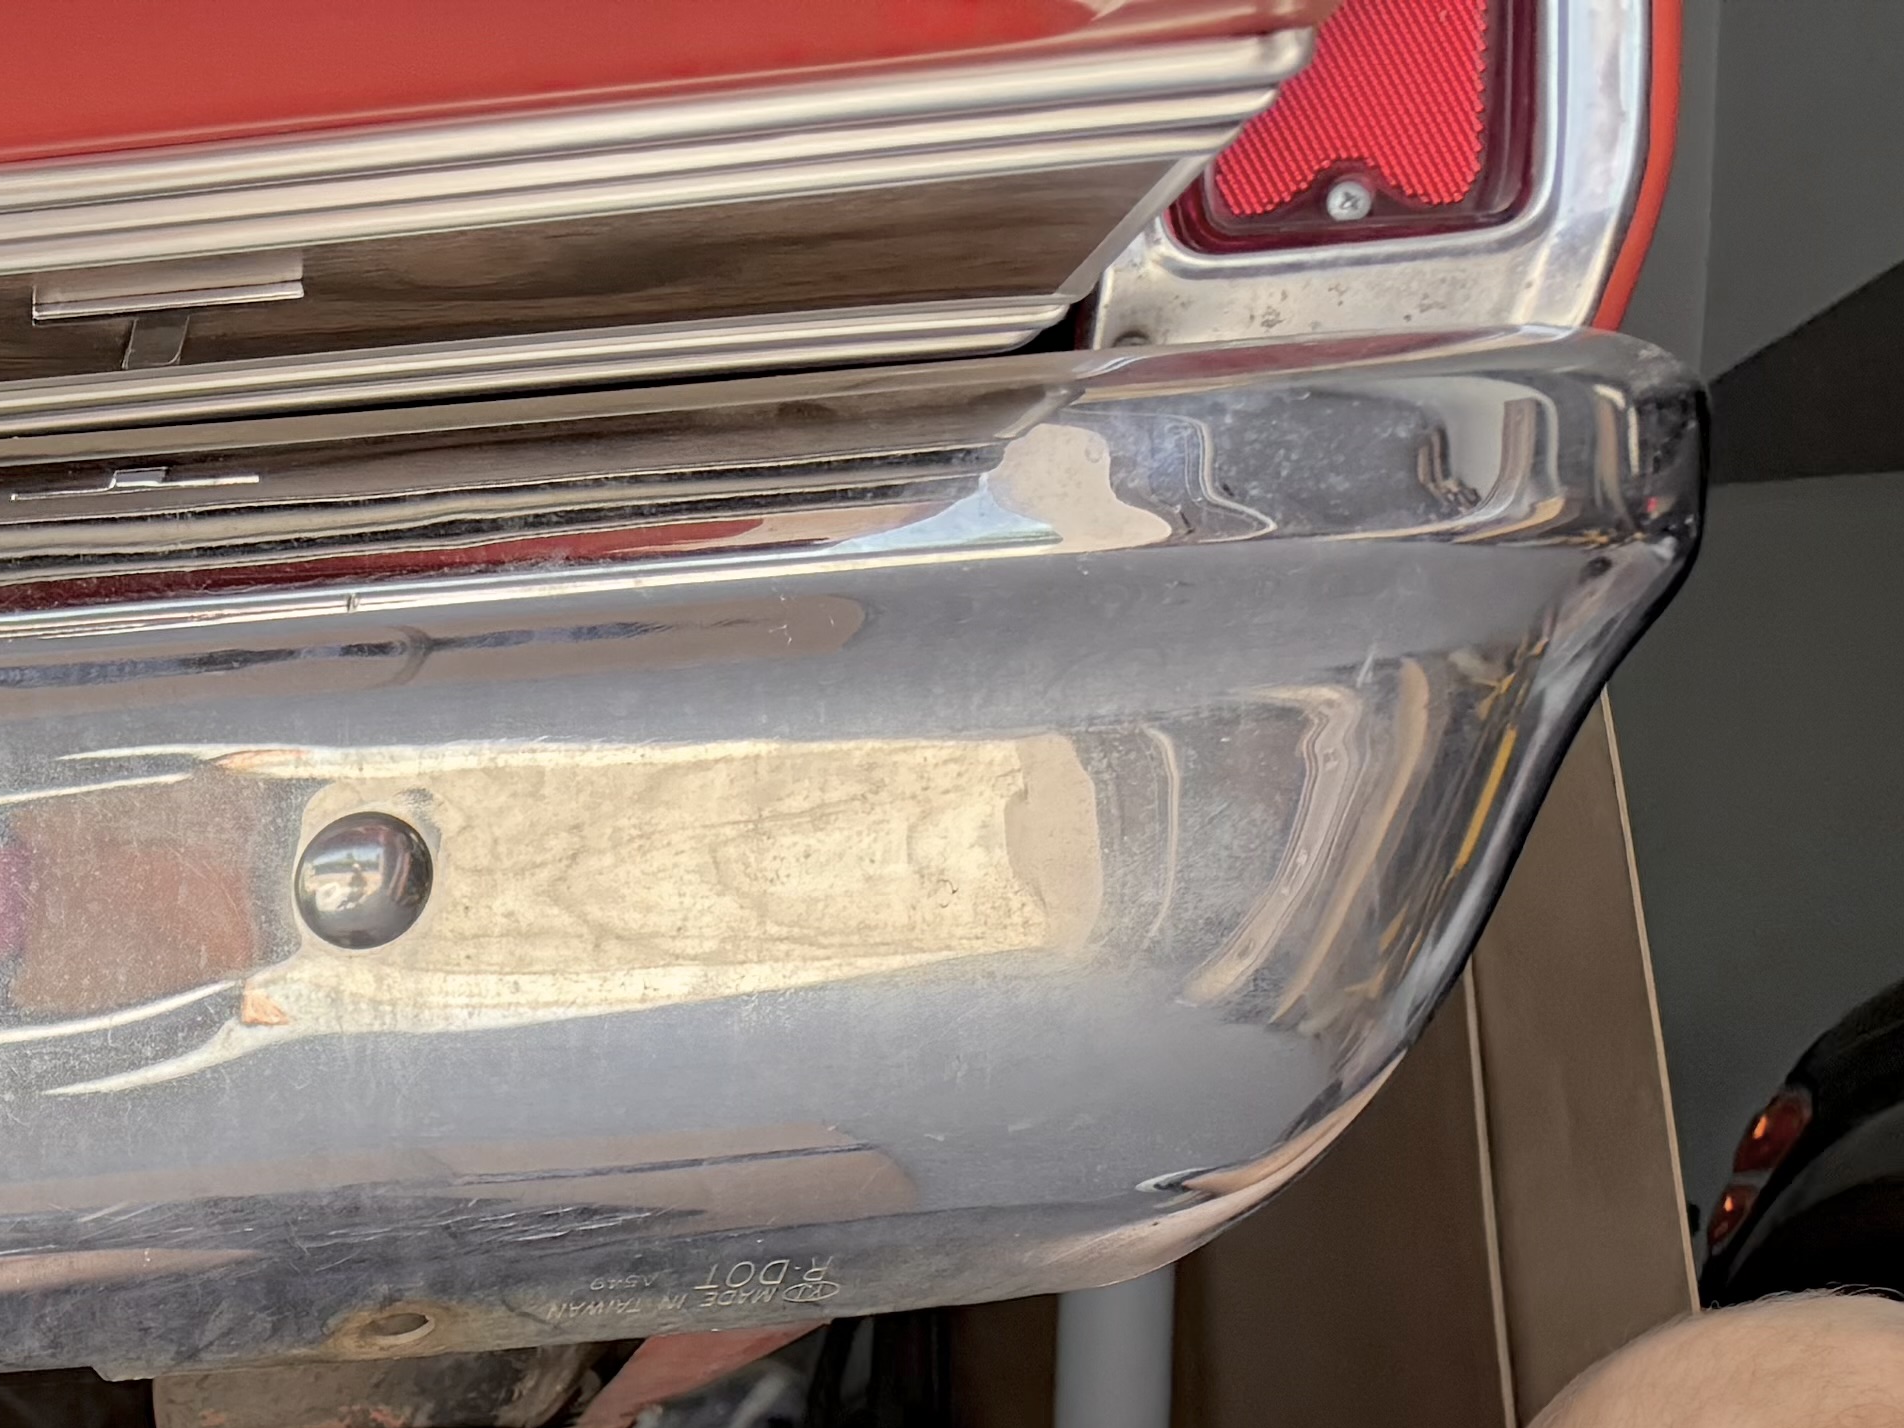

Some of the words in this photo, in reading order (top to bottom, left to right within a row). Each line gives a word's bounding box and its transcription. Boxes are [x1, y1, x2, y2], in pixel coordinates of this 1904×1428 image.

[655, 1292, 689, 1311] IN
[700, 1286, 779, 1308] MADE
[546, 1298, 642, 1320] TAIWAN
